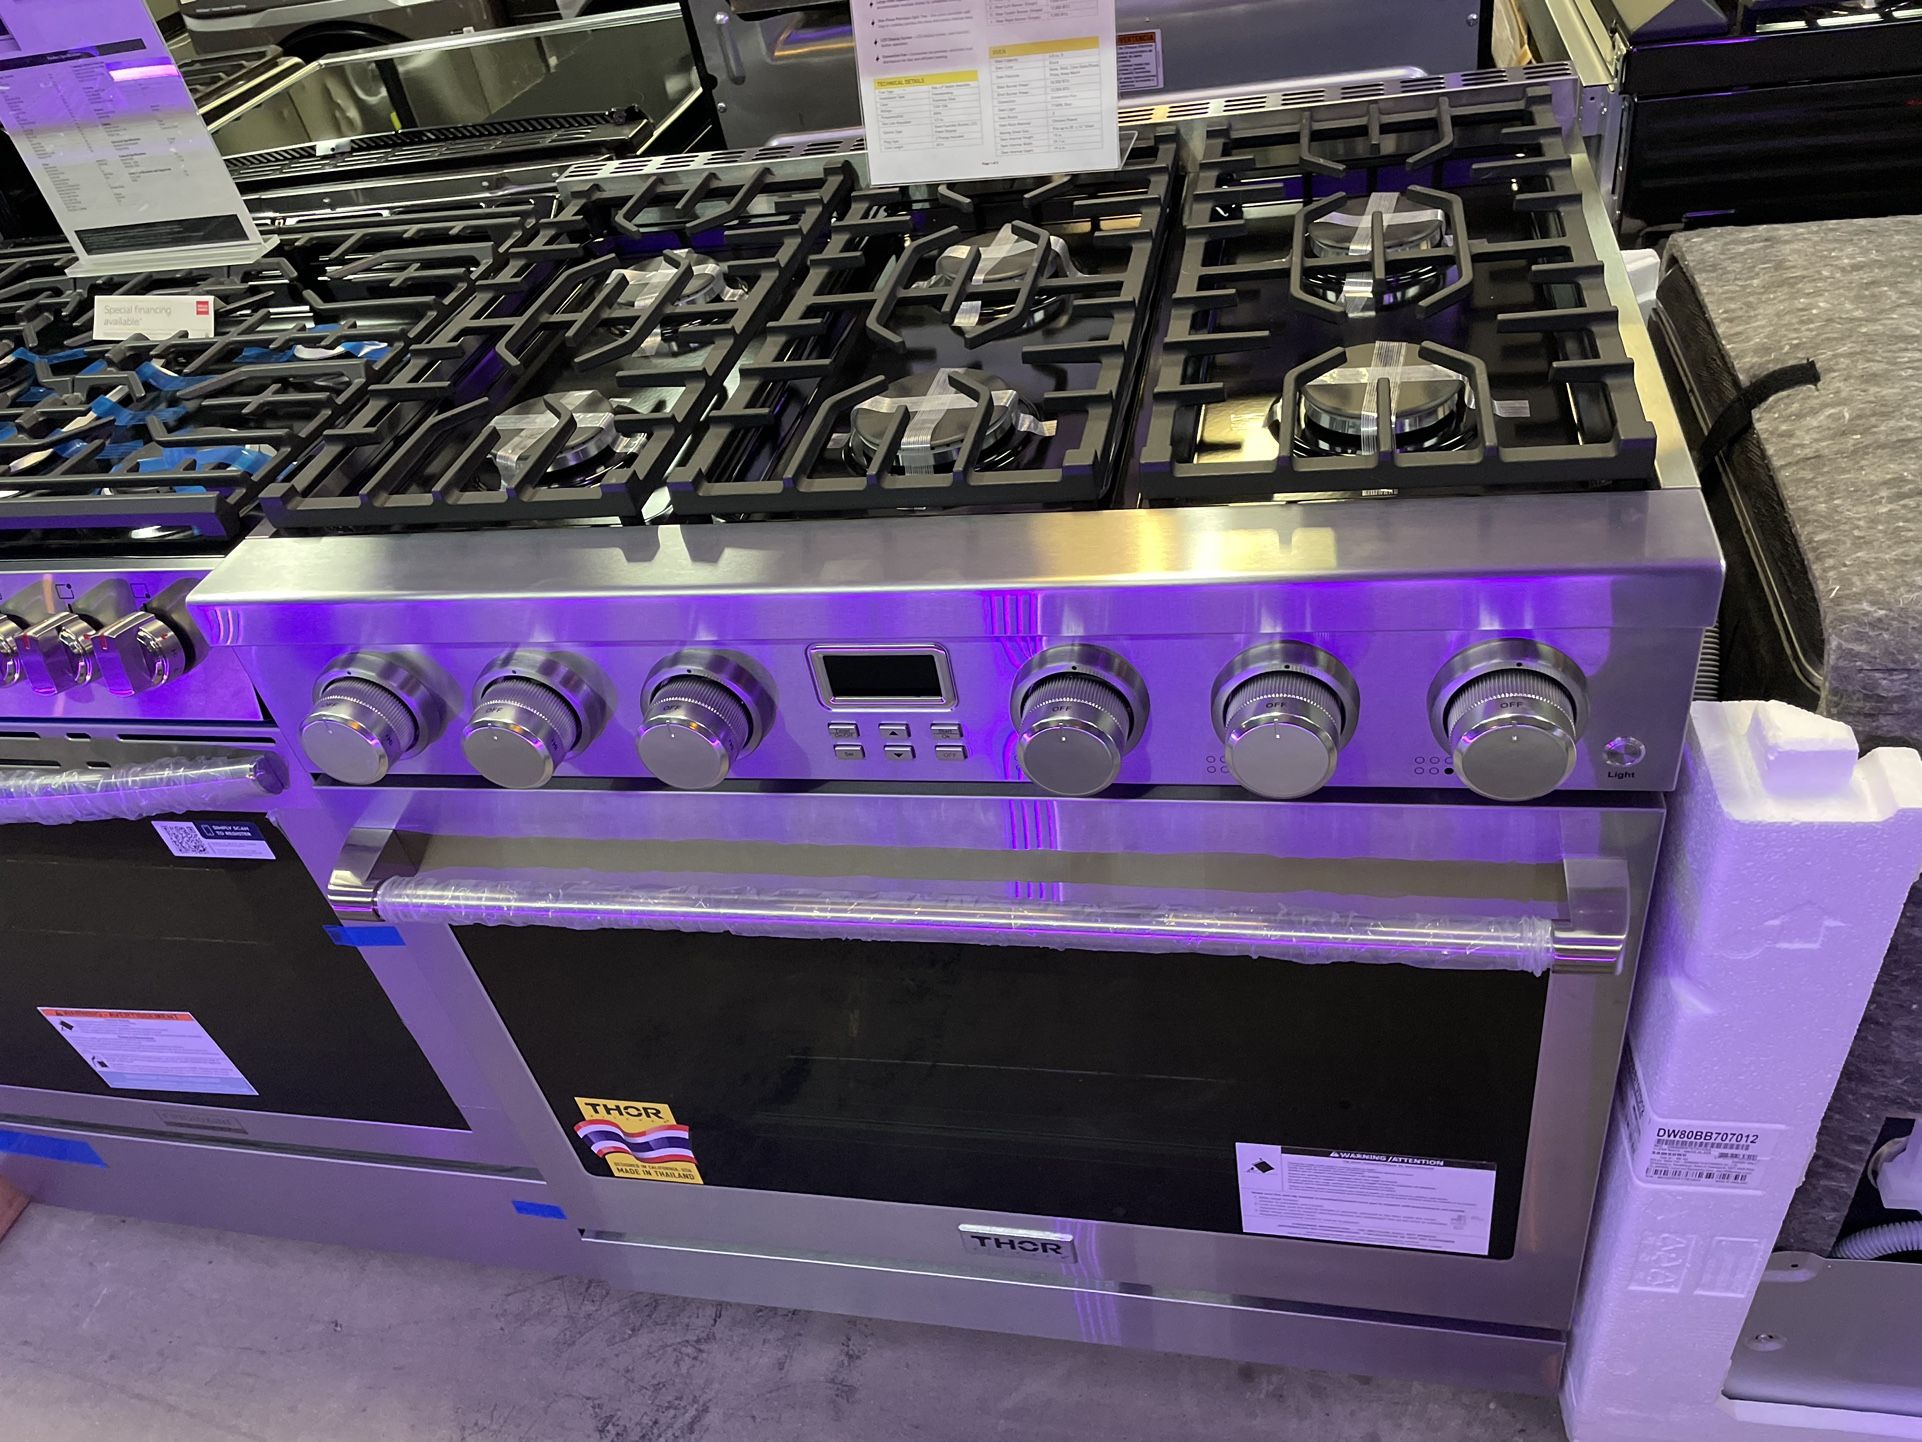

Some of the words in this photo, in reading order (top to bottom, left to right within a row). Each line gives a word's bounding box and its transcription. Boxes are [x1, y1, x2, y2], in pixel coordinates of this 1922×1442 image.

[104, 304, 133, 315] Special
[134, 304, 172, 315] financing
[1607, 771, 1635, 780] Light
[584, 1102, 664, 1120] THOR
[1656, 1127, 1759, 1144] DW80BB707012
[1340, 1152, 1387, 1161] WARNING
[616, 1167, 640, 1175] MADE
[654, 1171, 695, 1180] THAILAND
[970, 1235, 1063, 1255] THOR
